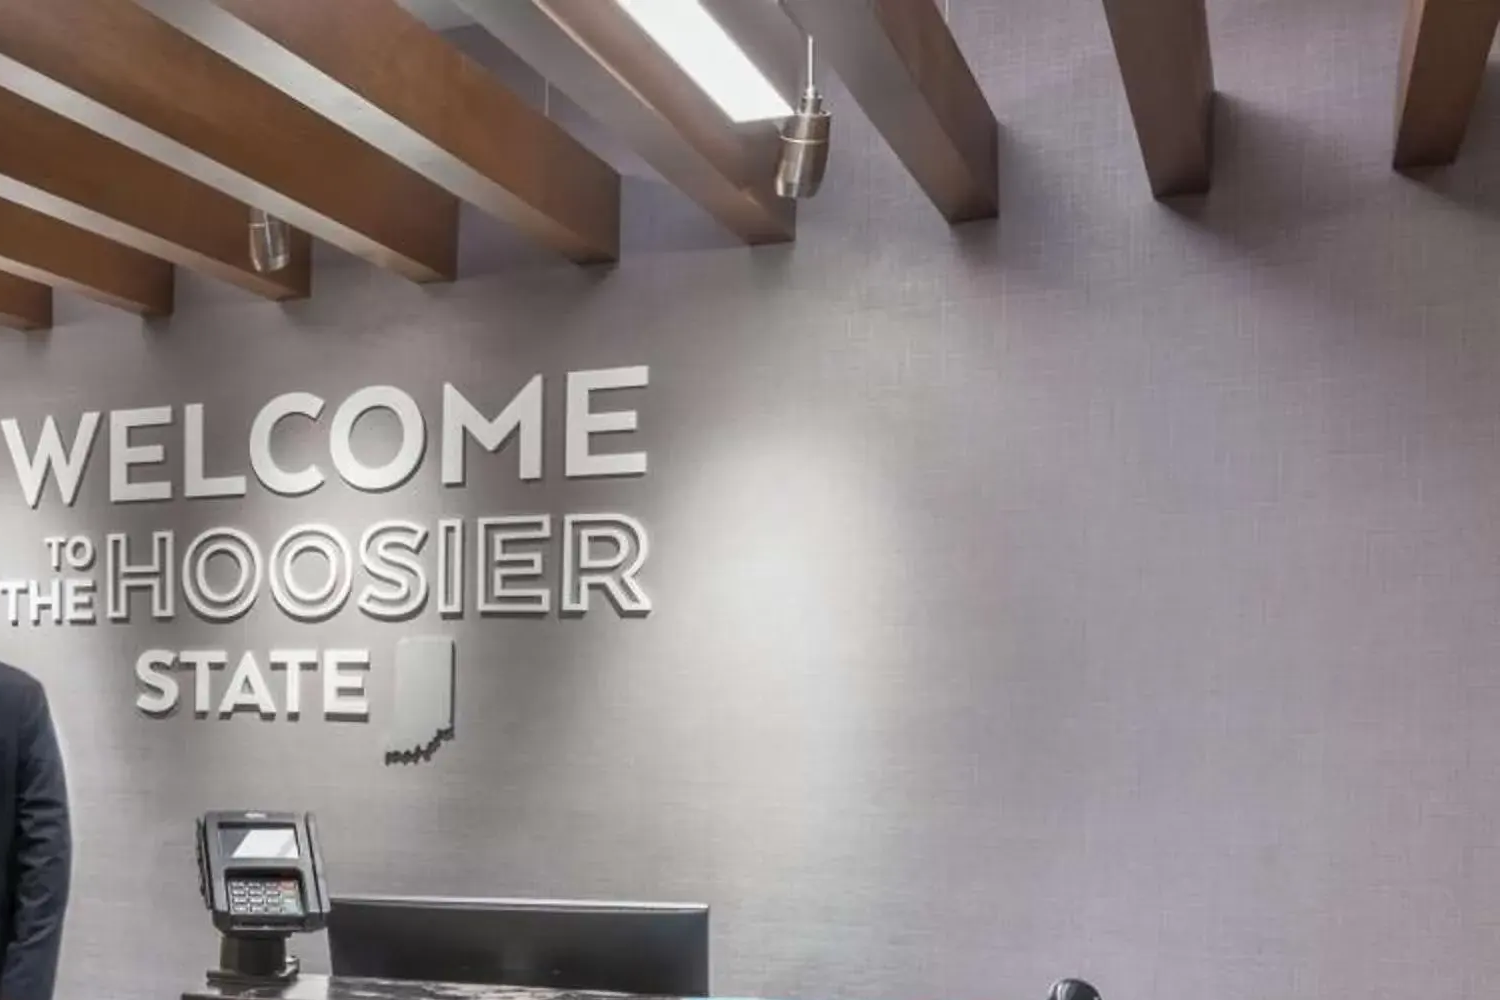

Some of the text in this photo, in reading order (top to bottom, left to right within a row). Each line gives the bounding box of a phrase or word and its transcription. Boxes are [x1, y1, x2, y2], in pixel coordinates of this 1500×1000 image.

[0, 365, 648, 509] WELCOME
[44, 535, 95, 571] TO
[106, 514, 652, 624] HOOSIER
[136, 649, 370, 721] STATE
